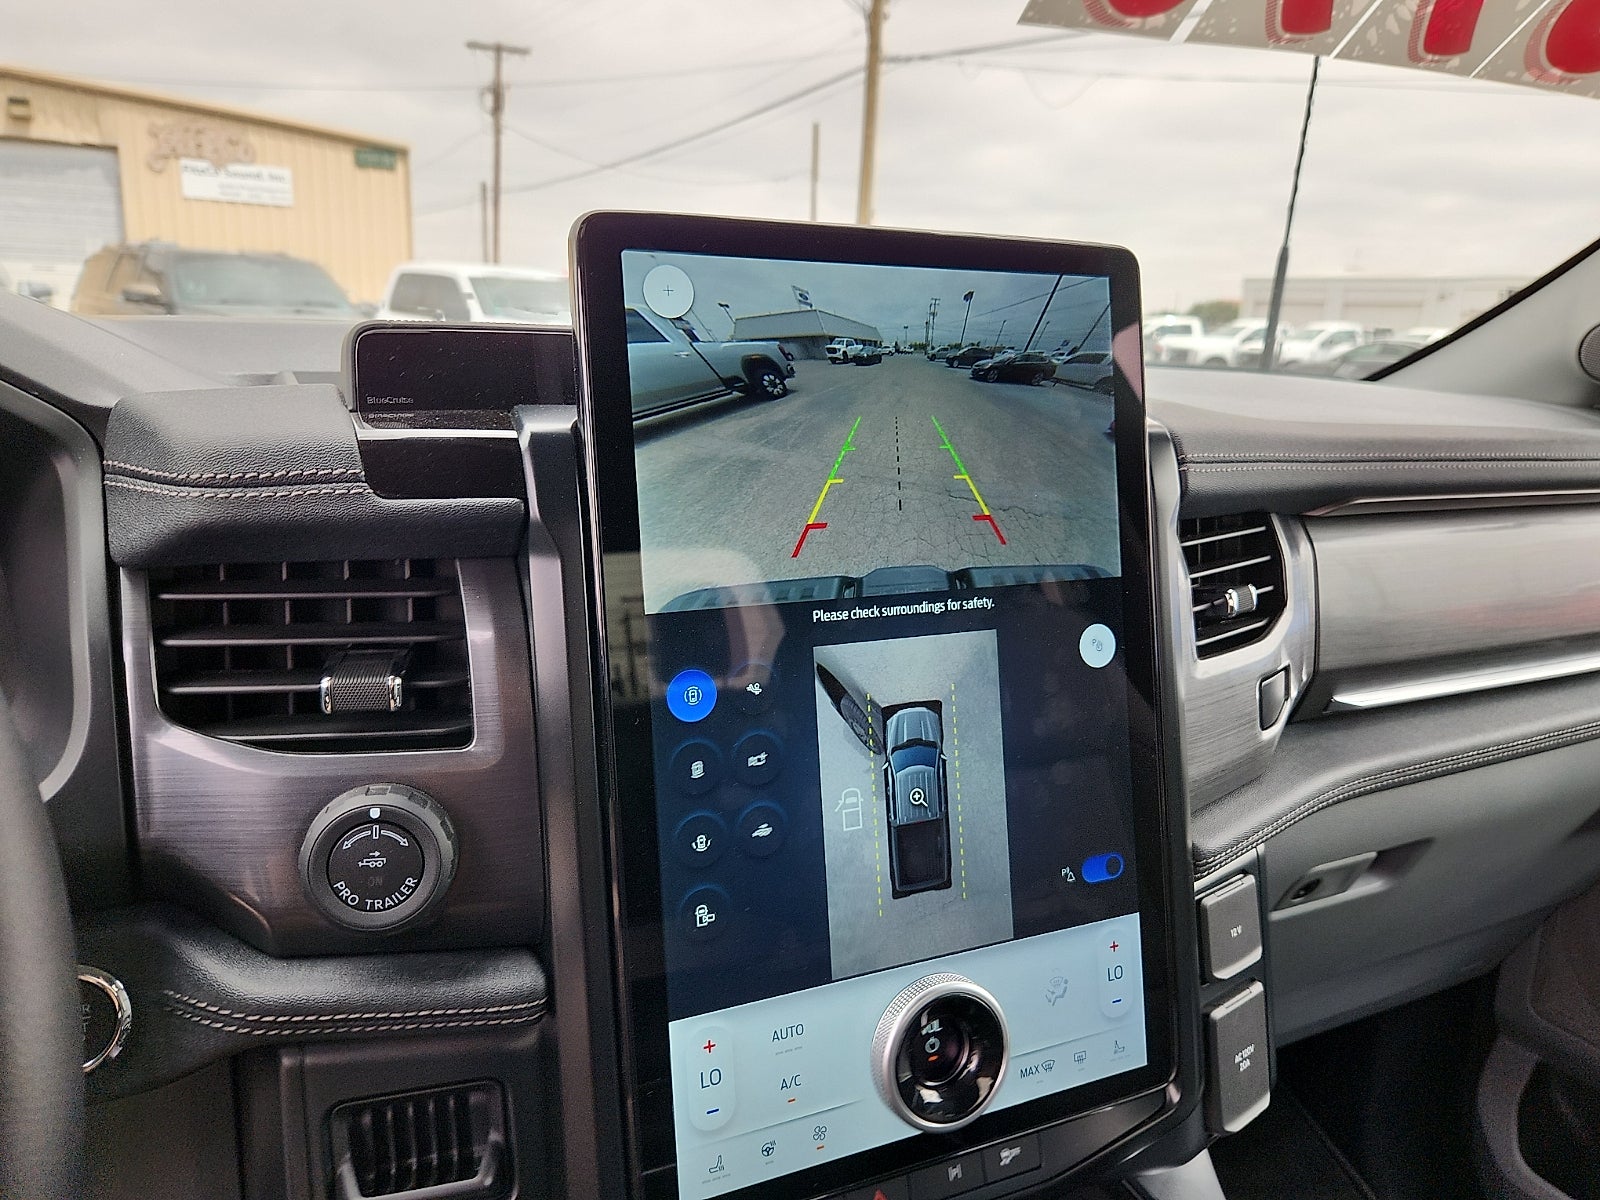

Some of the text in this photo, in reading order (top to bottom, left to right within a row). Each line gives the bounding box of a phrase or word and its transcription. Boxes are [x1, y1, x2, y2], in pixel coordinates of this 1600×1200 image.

[366, 396, 414, 404] BlueCruise
[812, 596, 995, 623] Please check surroundings for safety.
[333, 877, 418, 911] PRO TRAILER
[1106, 965, 1124, 982] LO
[771, 1023, 804, 1042] AUTO
[700, 1068, 722, 1089] LO
[1020, 1064, 1041, 1079] MAX
[780, 1074, 802, 1091] A/C
